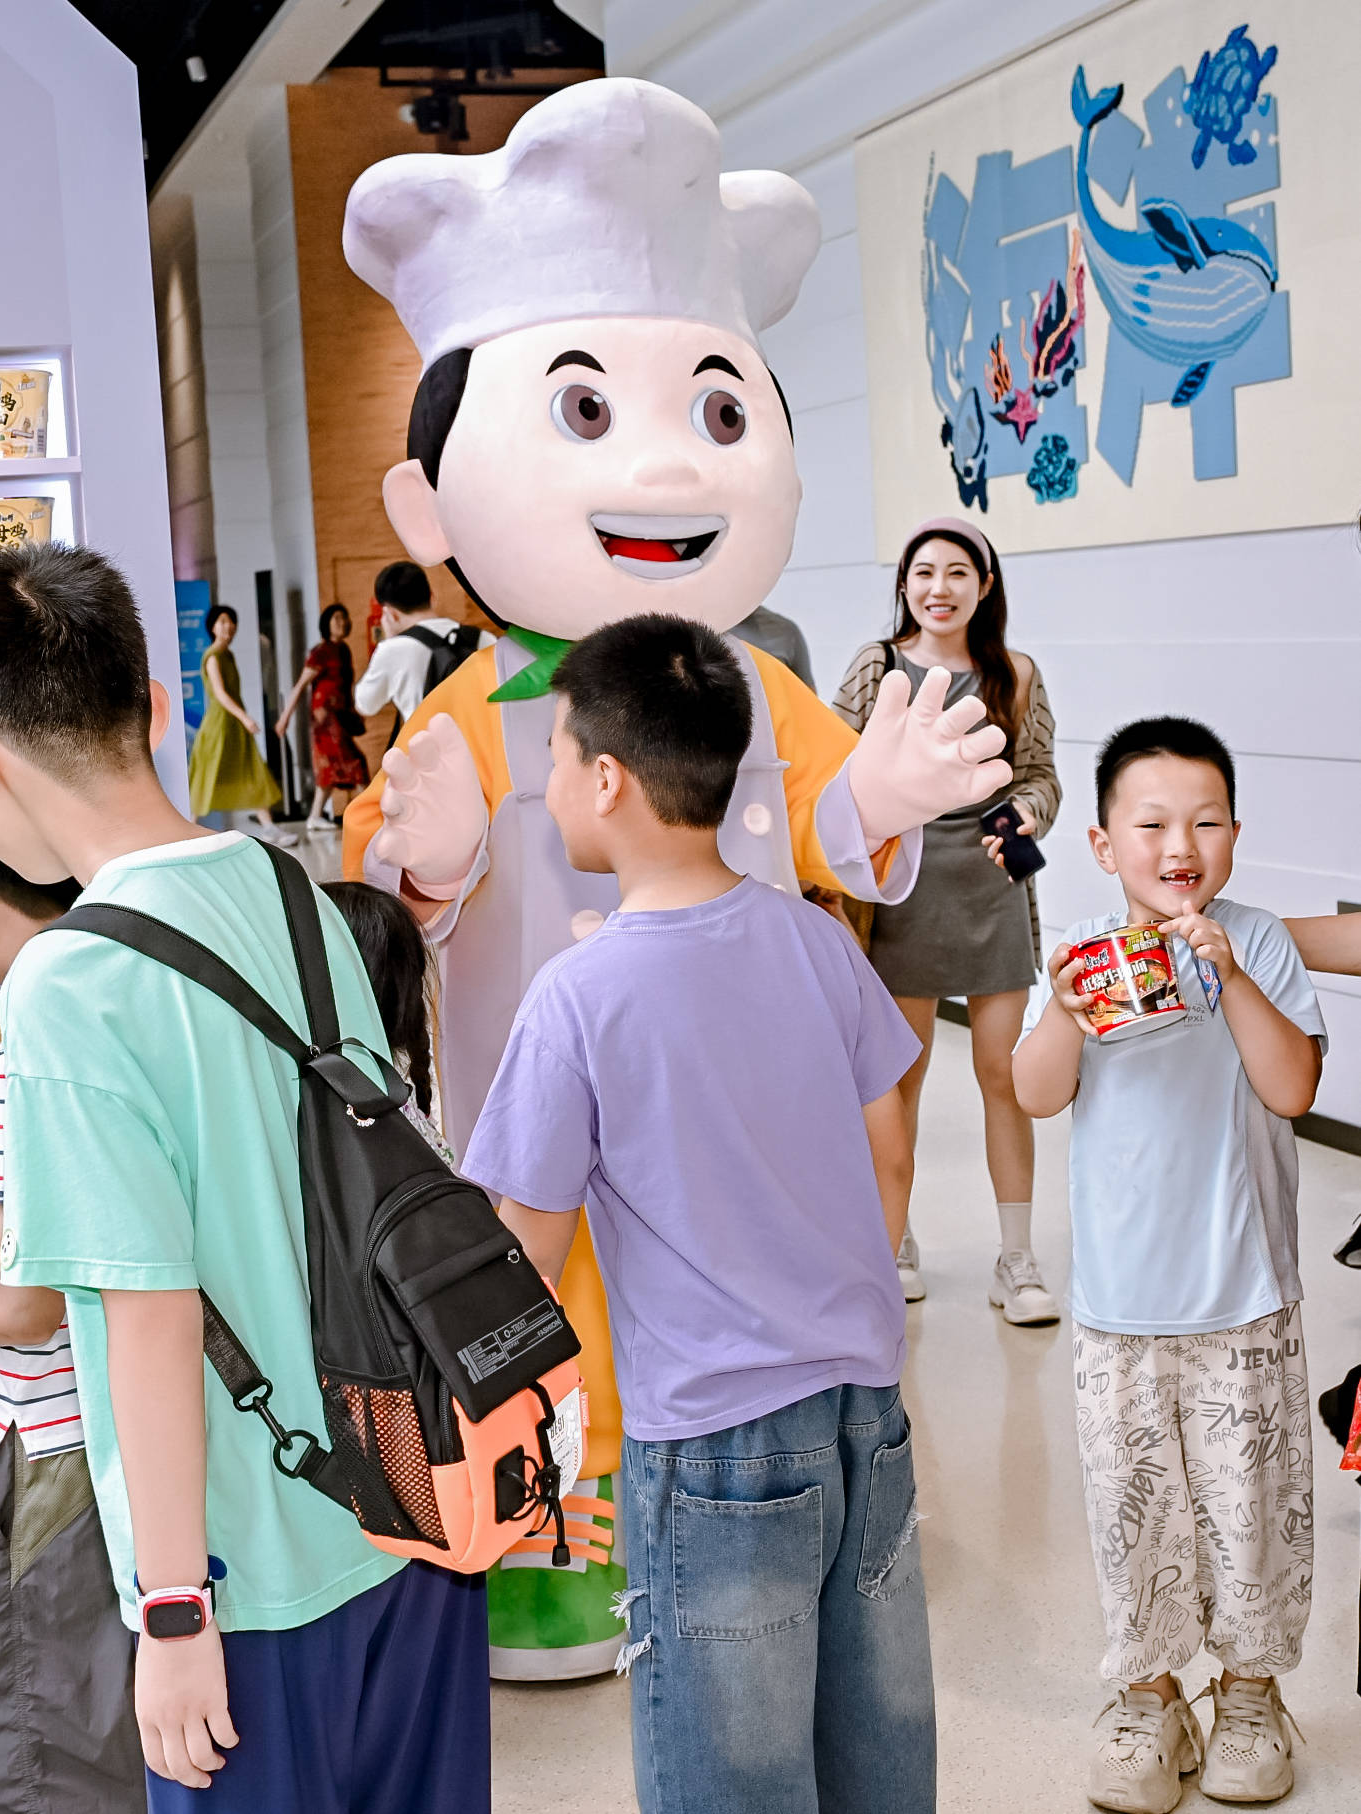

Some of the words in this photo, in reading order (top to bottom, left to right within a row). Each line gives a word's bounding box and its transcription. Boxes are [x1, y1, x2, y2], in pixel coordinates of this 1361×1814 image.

[1081, 960, 1149, 994] 红烧牛肉面
[1226, 1338, 1299, 1371] JIEWU
